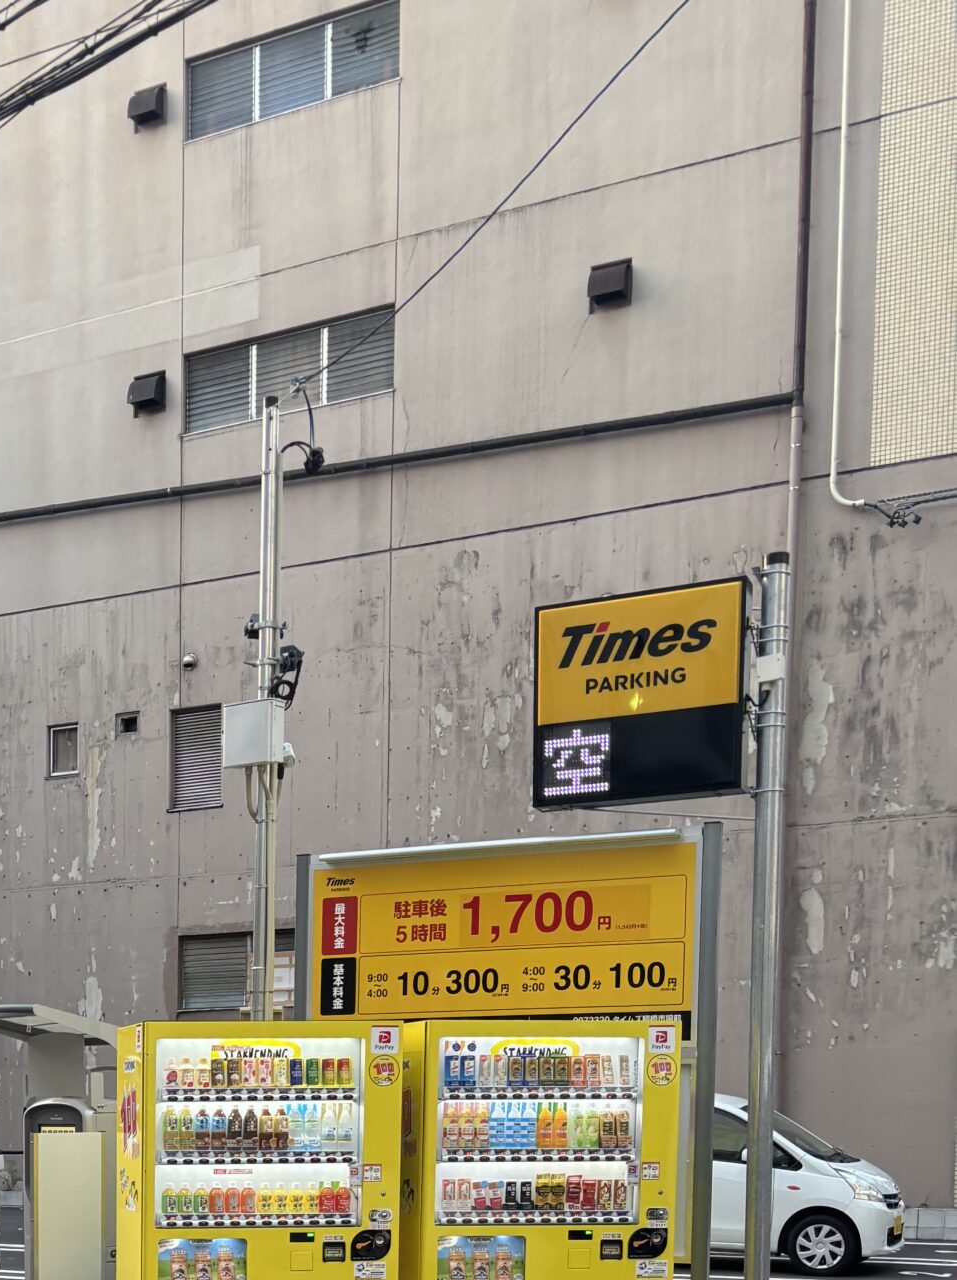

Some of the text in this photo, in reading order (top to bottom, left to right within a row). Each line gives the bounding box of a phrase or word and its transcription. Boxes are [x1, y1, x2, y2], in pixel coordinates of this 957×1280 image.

[558, 618, 718, 669] Times
[585, 667, 687, 694] PARKING
[544, 729, 610, 797] 空
[325, 877, 356, 887] Times
[393, 899, 447, 919] 駐車後
[333, 902, 346, 949] 最大料金
[395, 923, 447, 943] 5時間
[367, 973, 388, 983] 9:00
[522, 966, 545, 976] 4:00
[332, 963, 345, 1010] 基本料金
[367, 988, 388, 998] 4:00
[522, 982, 545, 993] 9:00
